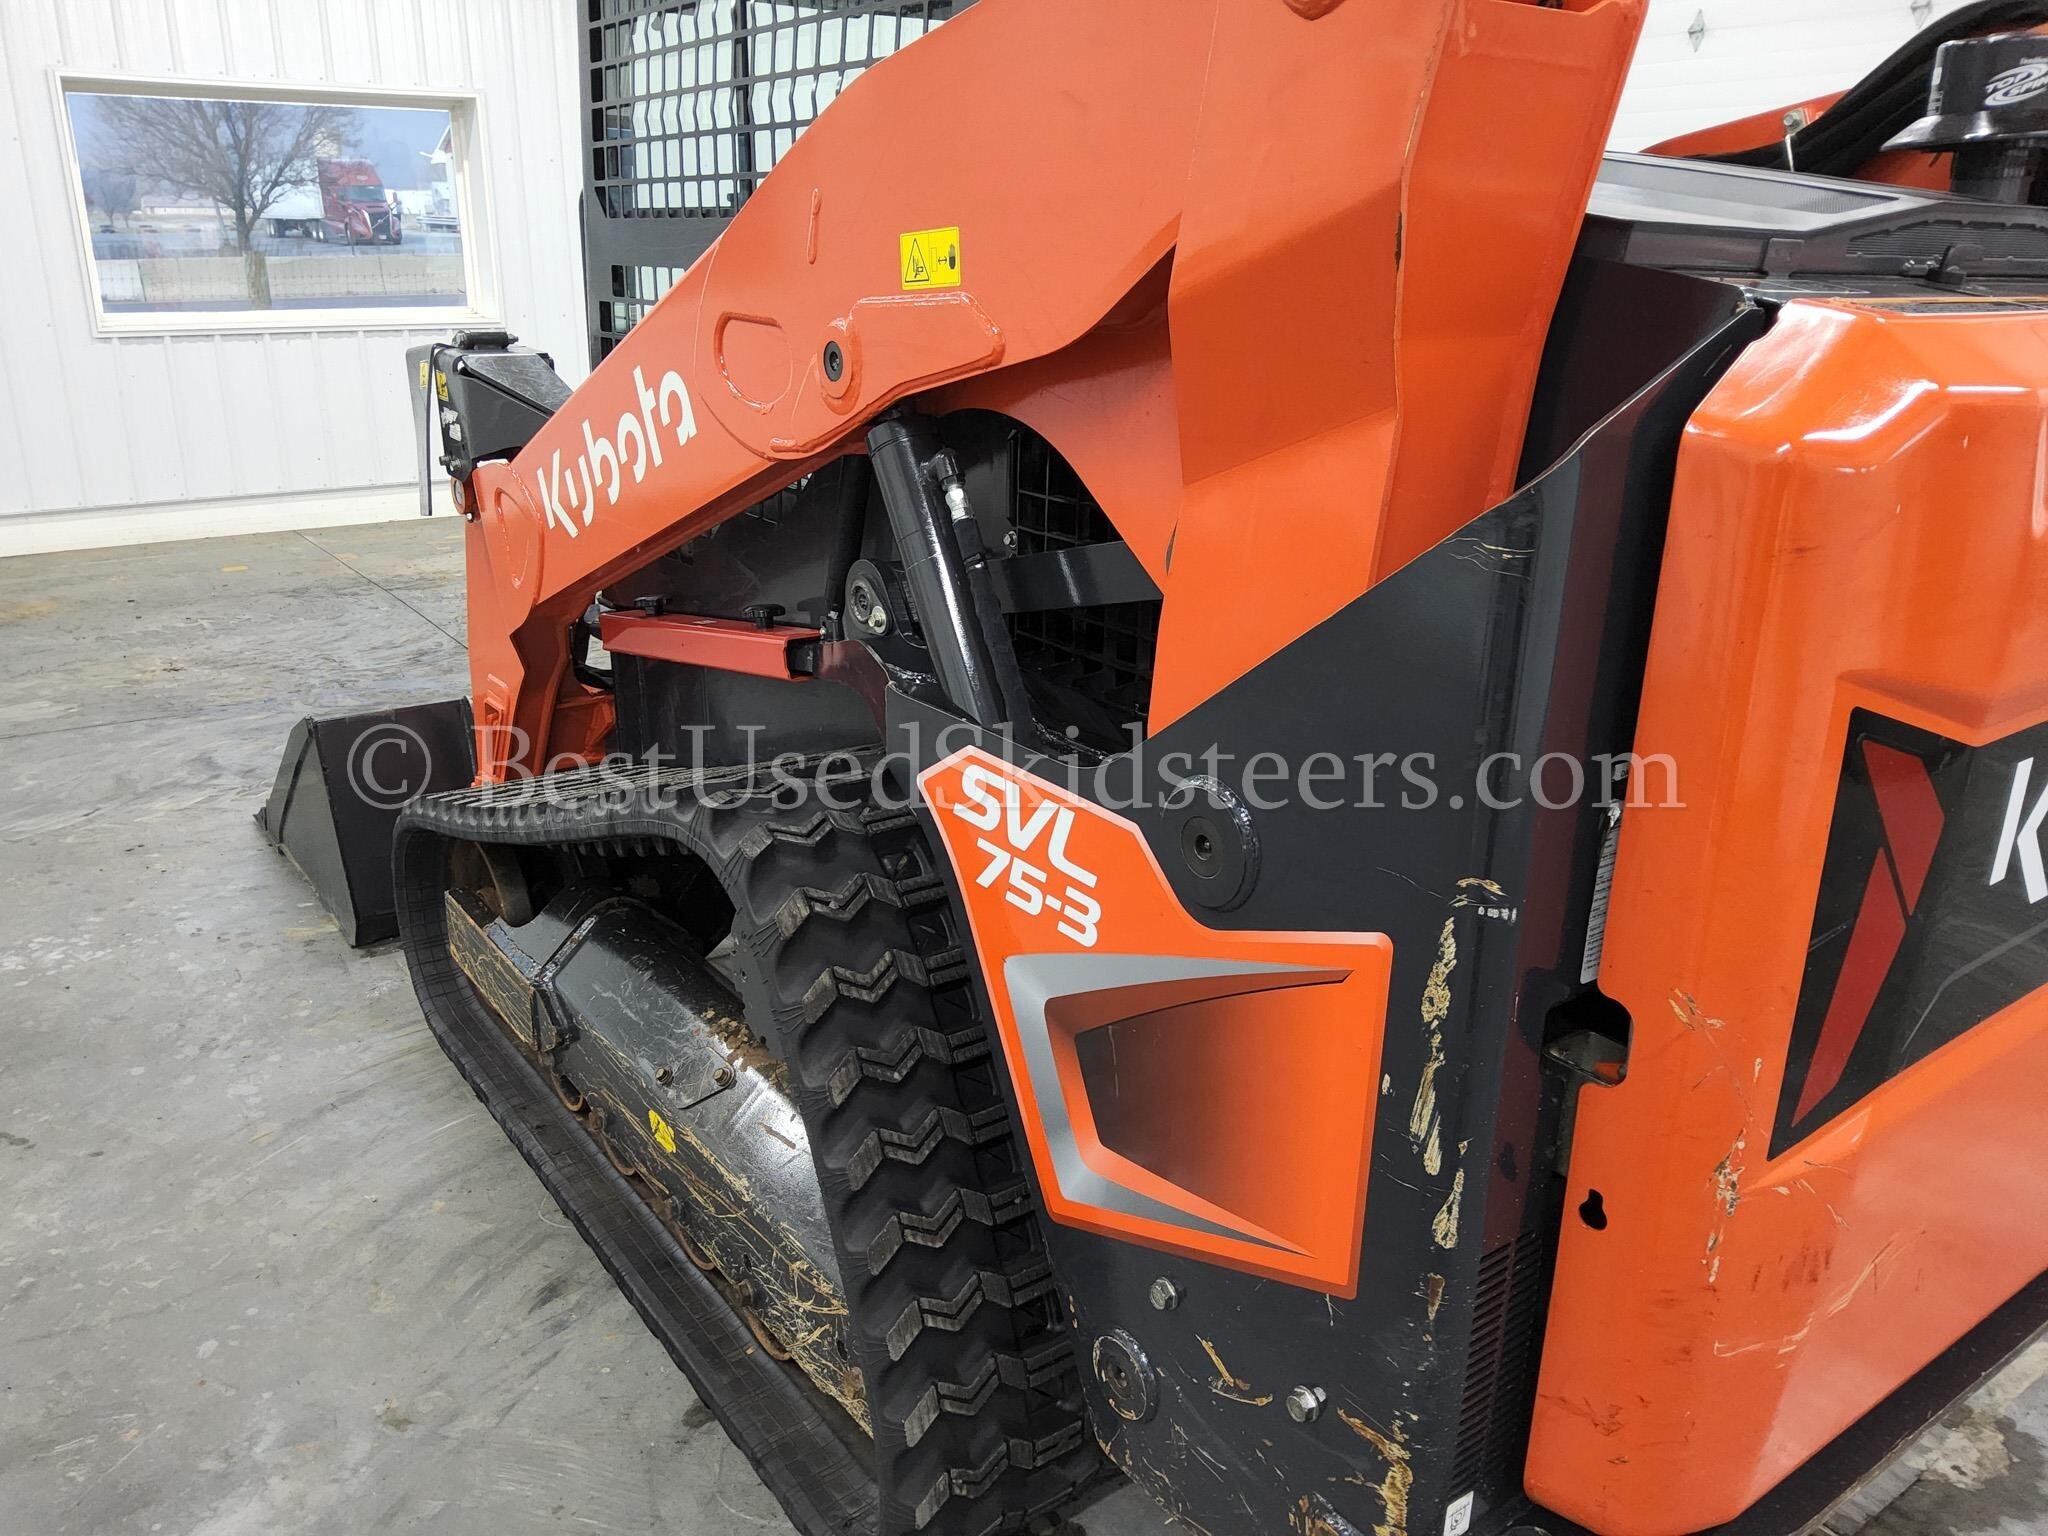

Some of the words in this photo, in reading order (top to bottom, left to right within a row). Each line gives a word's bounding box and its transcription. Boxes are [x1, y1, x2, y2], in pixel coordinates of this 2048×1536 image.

[537, 365, 697, 538] Kubota
[953, 764, 1097, 888] SVL
[976, 837, 1101, 947] 75-3
